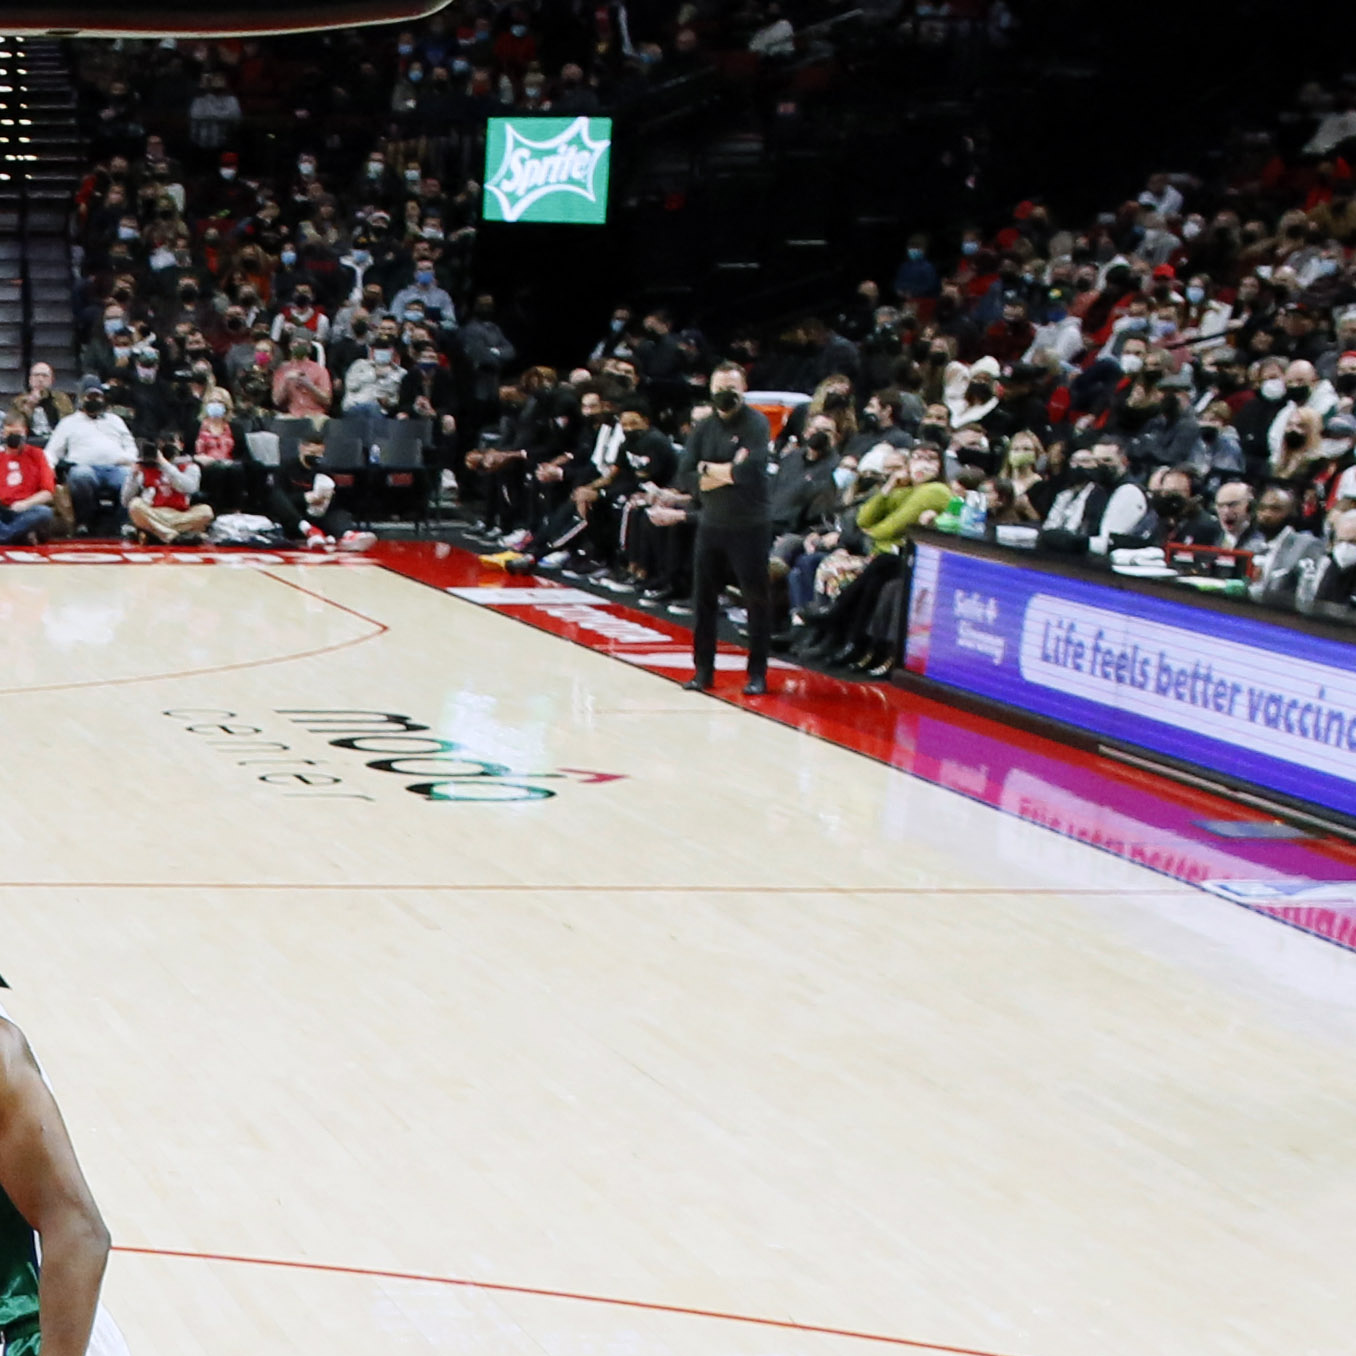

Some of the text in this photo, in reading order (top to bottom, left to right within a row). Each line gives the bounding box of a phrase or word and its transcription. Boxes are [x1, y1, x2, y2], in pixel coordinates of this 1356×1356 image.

[501, 142, 591, 196] Sprite
[1042, 618, 1085, 673] Life
[1090, 629, 1151, 690] feels
[1154, 651, 1241, 716] better
[162, 707, 375, 803] center
